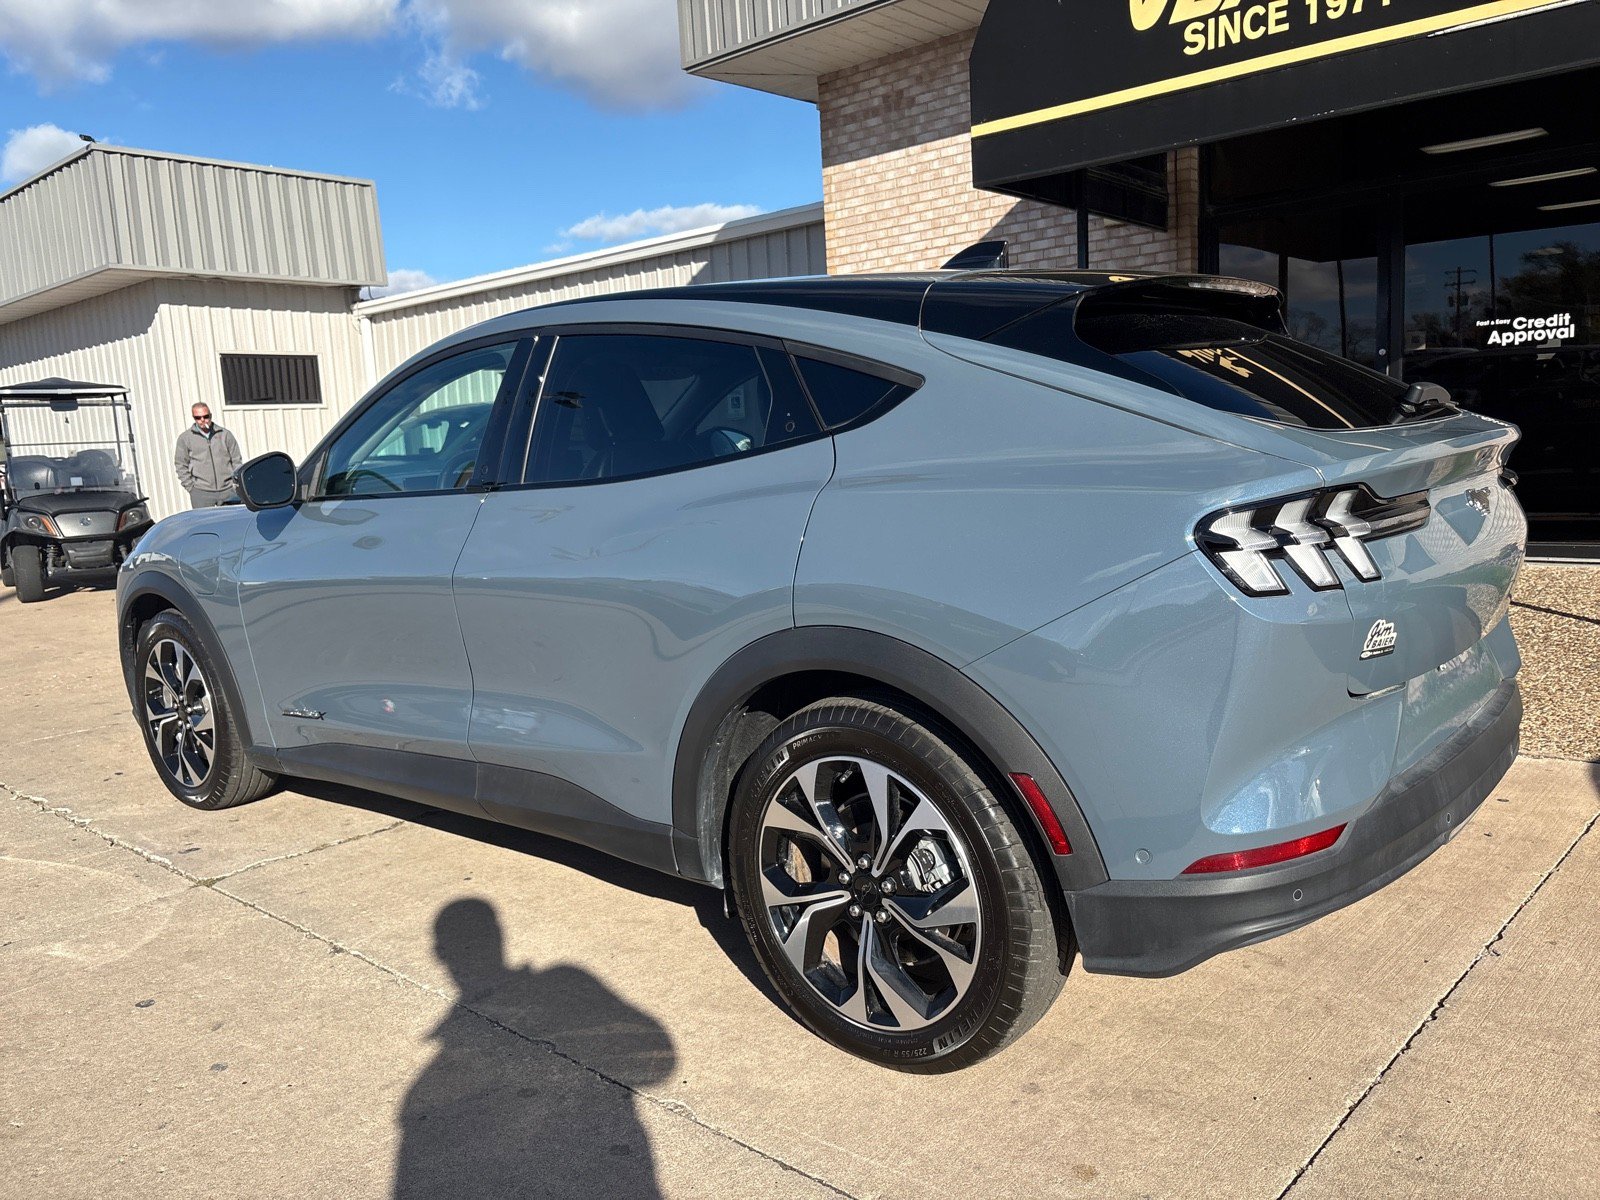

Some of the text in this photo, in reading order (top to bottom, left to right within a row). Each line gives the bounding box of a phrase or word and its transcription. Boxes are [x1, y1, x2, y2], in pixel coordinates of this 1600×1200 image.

[1183, 1, 1290, 56] SINCE
[1305, 0, 1392, 25] 19
[1512, 313, 1571, 330] Credit
[1487, 323, 1575, 346] Approval
[1366, 621, 1392, 649] Jim
[792, 734, 823, 750] PRIMACY
[901, 1047, 928, 1058] 225/55
